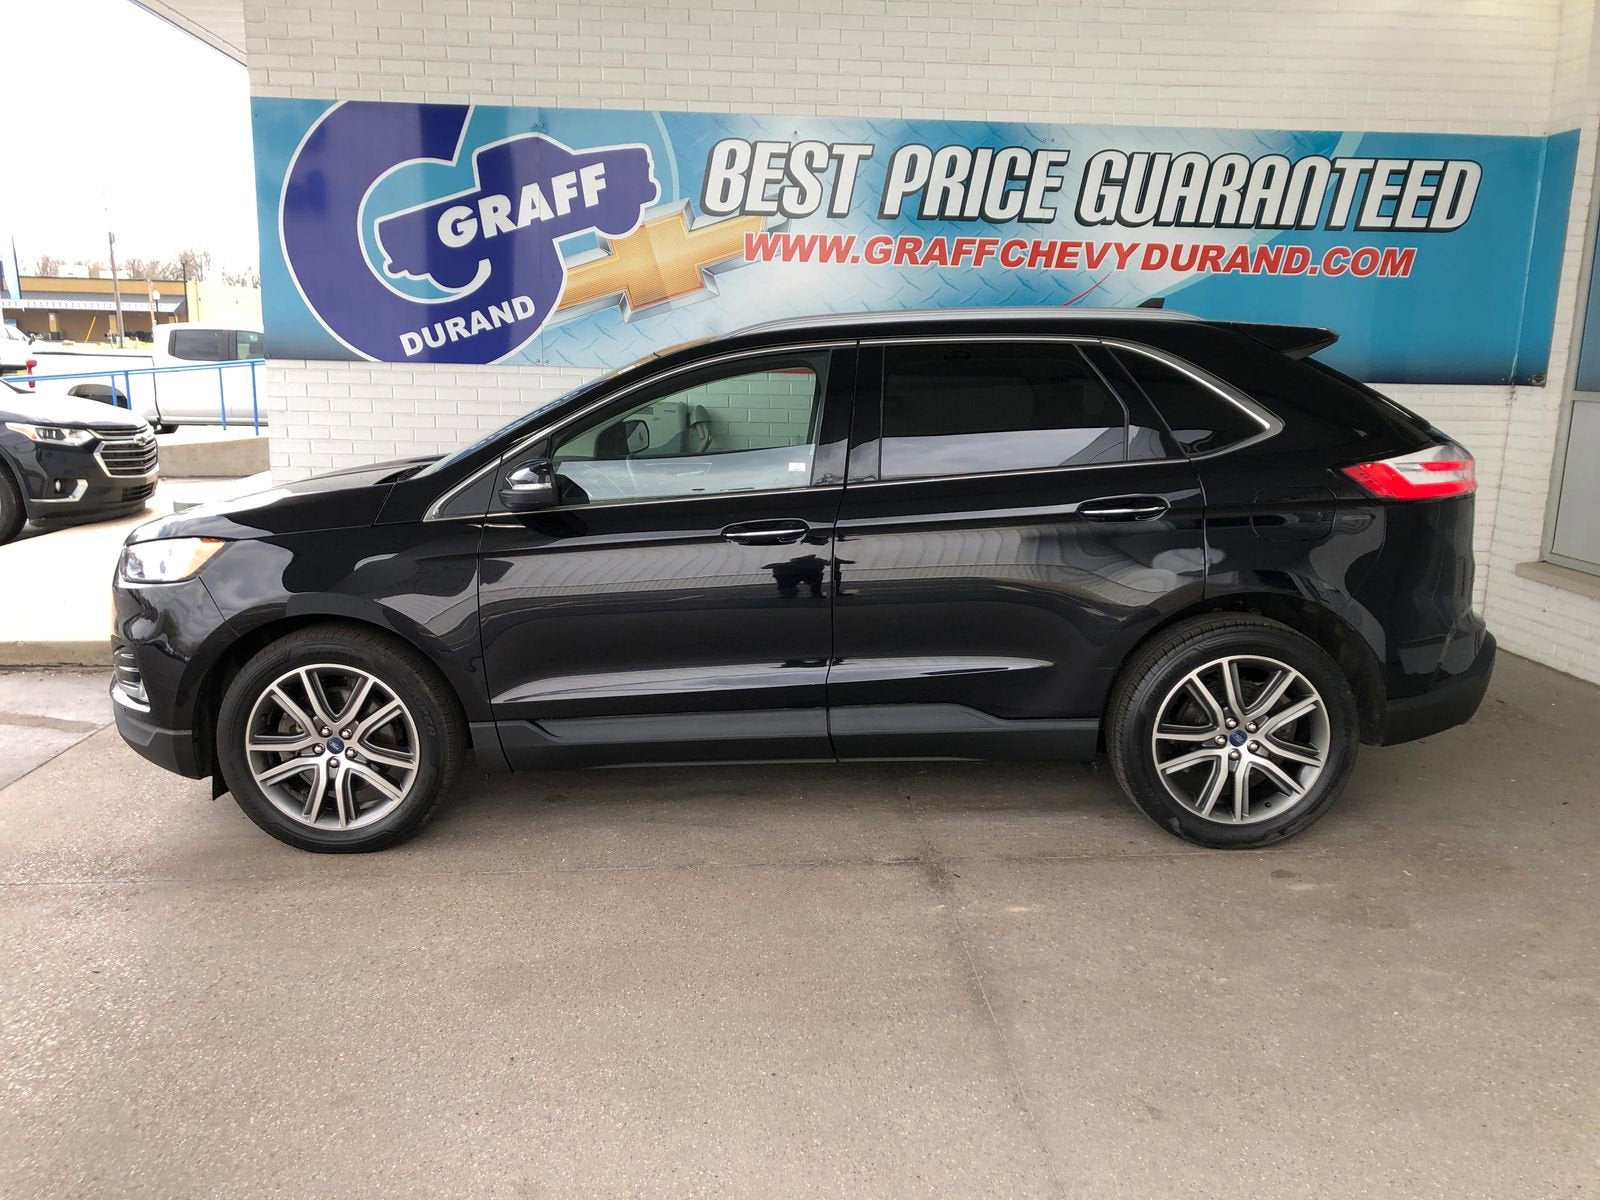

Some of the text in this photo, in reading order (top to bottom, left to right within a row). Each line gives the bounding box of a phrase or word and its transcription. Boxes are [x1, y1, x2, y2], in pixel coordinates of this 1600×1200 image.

[437, 162, 606, 248] GRAFF
[702, 138, 1482, 232] BEST PRICE GUARANTEED
[743, 231, 1419, 279] WWW.GRAFFCHEVYDURAND.COM
[399, 295, 536, 357] DURAND
